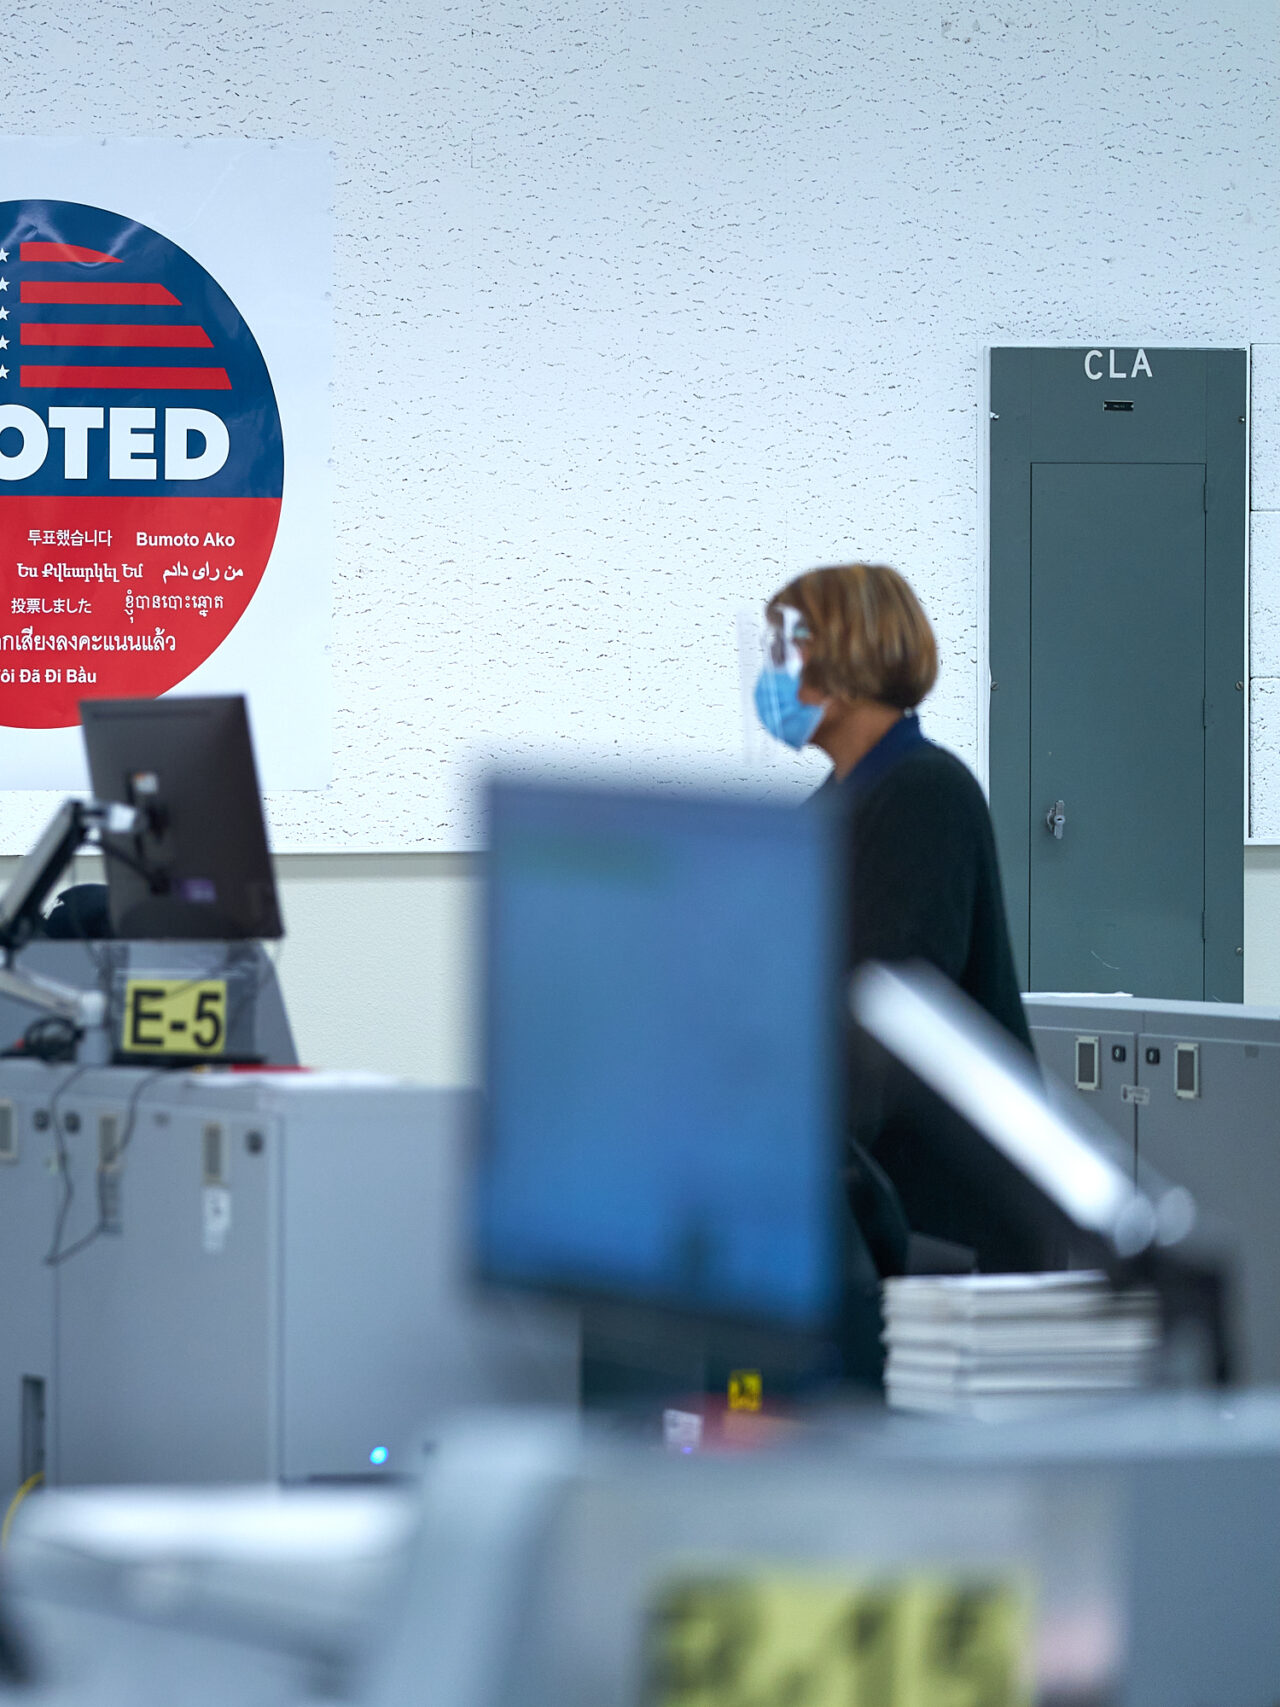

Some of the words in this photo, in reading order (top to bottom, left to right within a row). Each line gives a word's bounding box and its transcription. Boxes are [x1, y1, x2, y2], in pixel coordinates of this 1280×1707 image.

[1084, 348, 1153, 380] CLA
[27, 529, 113, 547] 투표했습니다
[136, 532, 200, 547] Bumoto
[203, 532, 236, 547] Ako
[16, 563, 39, 578] Ես
[162, 561, 189, 584] دادم
[223, 565, 244, 581] من
[11, 598, 92, 614] 投票しました
[18, 668, 41, 684] Đã
[44, 668, 62, 684] Đi
[131, 987, 222, 1050] E-5
